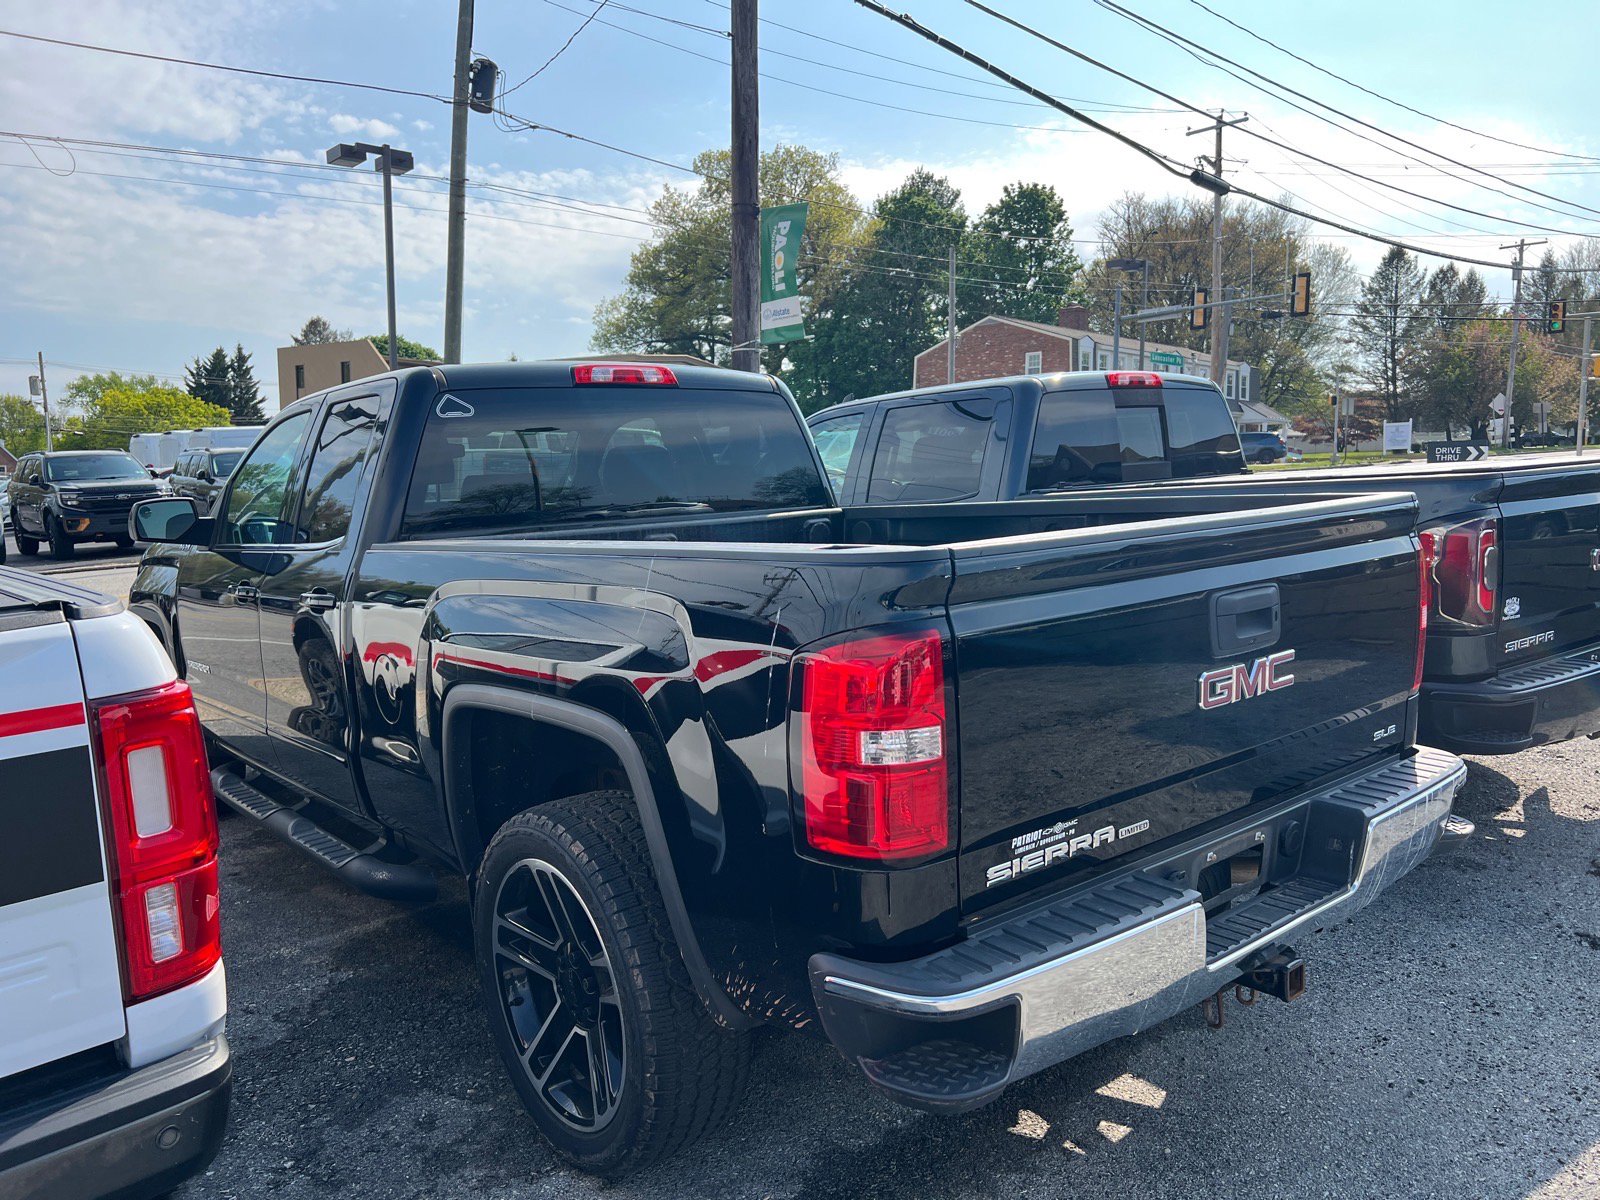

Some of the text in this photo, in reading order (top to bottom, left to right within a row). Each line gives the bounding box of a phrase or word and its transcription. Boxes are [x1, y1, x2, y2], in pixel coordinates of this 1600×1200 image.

[775, 220, 791, 291] PAOLI
[772, 308, 790, 317] Allstate
[1152, 354, 1175, 363] Lancaster
[1435, 446, 1461, 454] DRIVE
[1505, 630, 1554, 653] SIERRA
[1199, 649, 1295, 710] GMC
[1373, 724, 1396, 741] SLE
[1011, 819, 1078, 849] PATRIOT GMC
[986, 821, 1149, 887] SIERRA LIMITED
